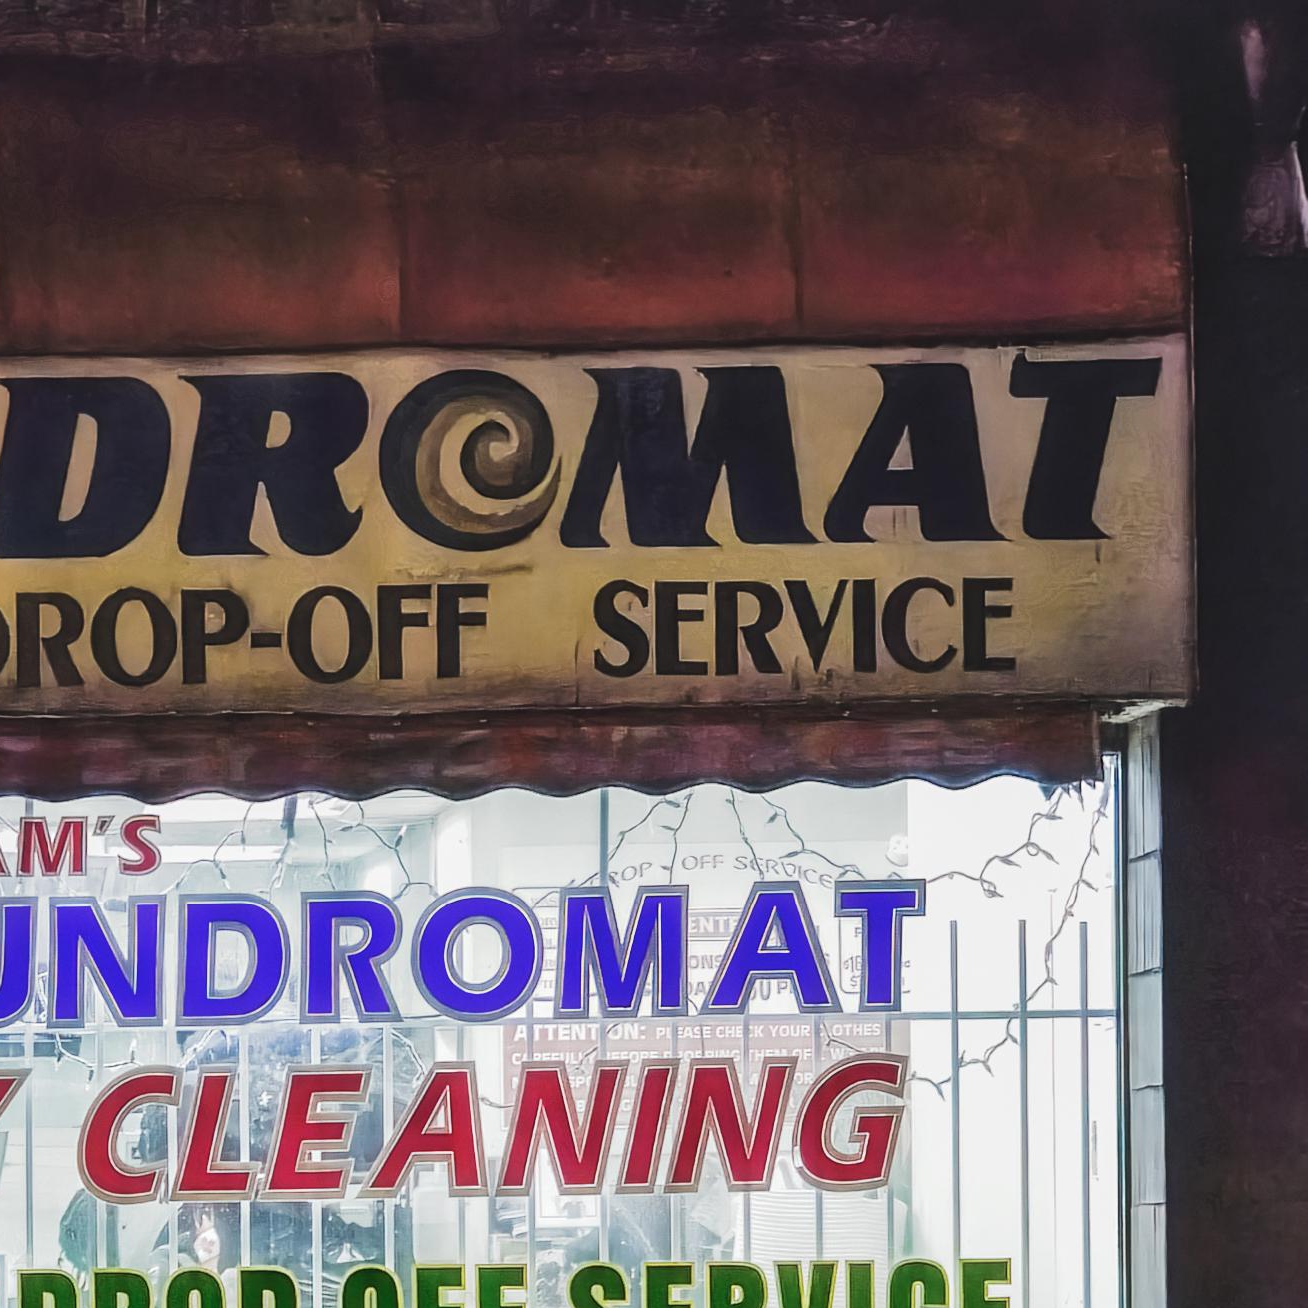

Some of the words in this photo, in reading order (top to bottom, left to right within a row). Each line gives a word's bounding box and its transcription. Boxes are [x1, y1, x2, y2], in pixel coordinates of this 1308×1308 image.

[592, 576, 1016, 679] SERVICE
[681, 854, 724, 871] OFF
[514, 1022, 646, 1042] ATTENTON:
[716, 1025, 764, 1039] CHECK
[769, 1024, 811, 1038] YOUR
[820, 1023, 882, 1037] OTHES
[76, 1054, 909, 1206] CLEANING
